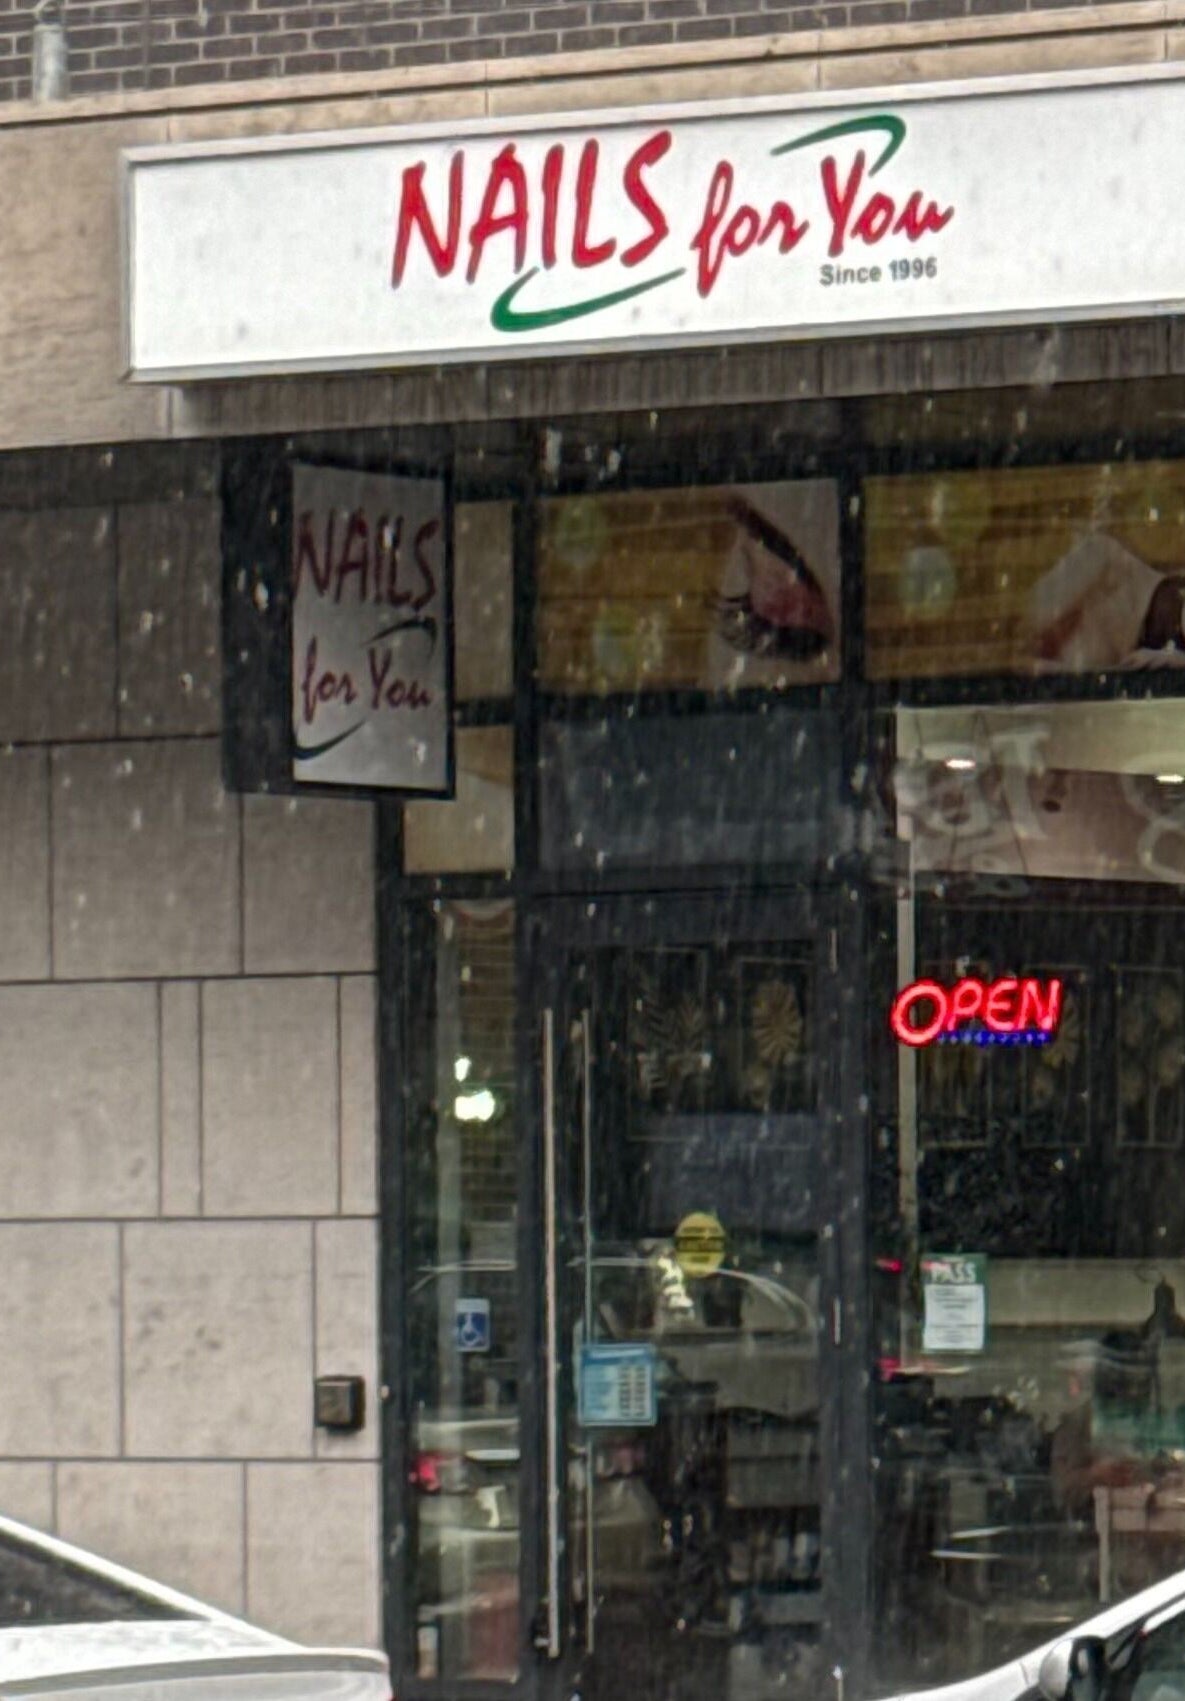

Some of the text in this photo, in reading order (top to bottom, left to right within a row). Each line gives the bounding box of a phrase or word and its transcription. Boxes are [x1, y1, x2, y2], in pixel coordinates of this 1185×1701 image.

[391, 130, 954, 298] NAILS for You
[819, 256, 939, 286] Since 1996
[294, 506, 440, 611] NAILS
[302, 636, 434, 726] for You
[891, 976, 1062, 1047] OPEN
